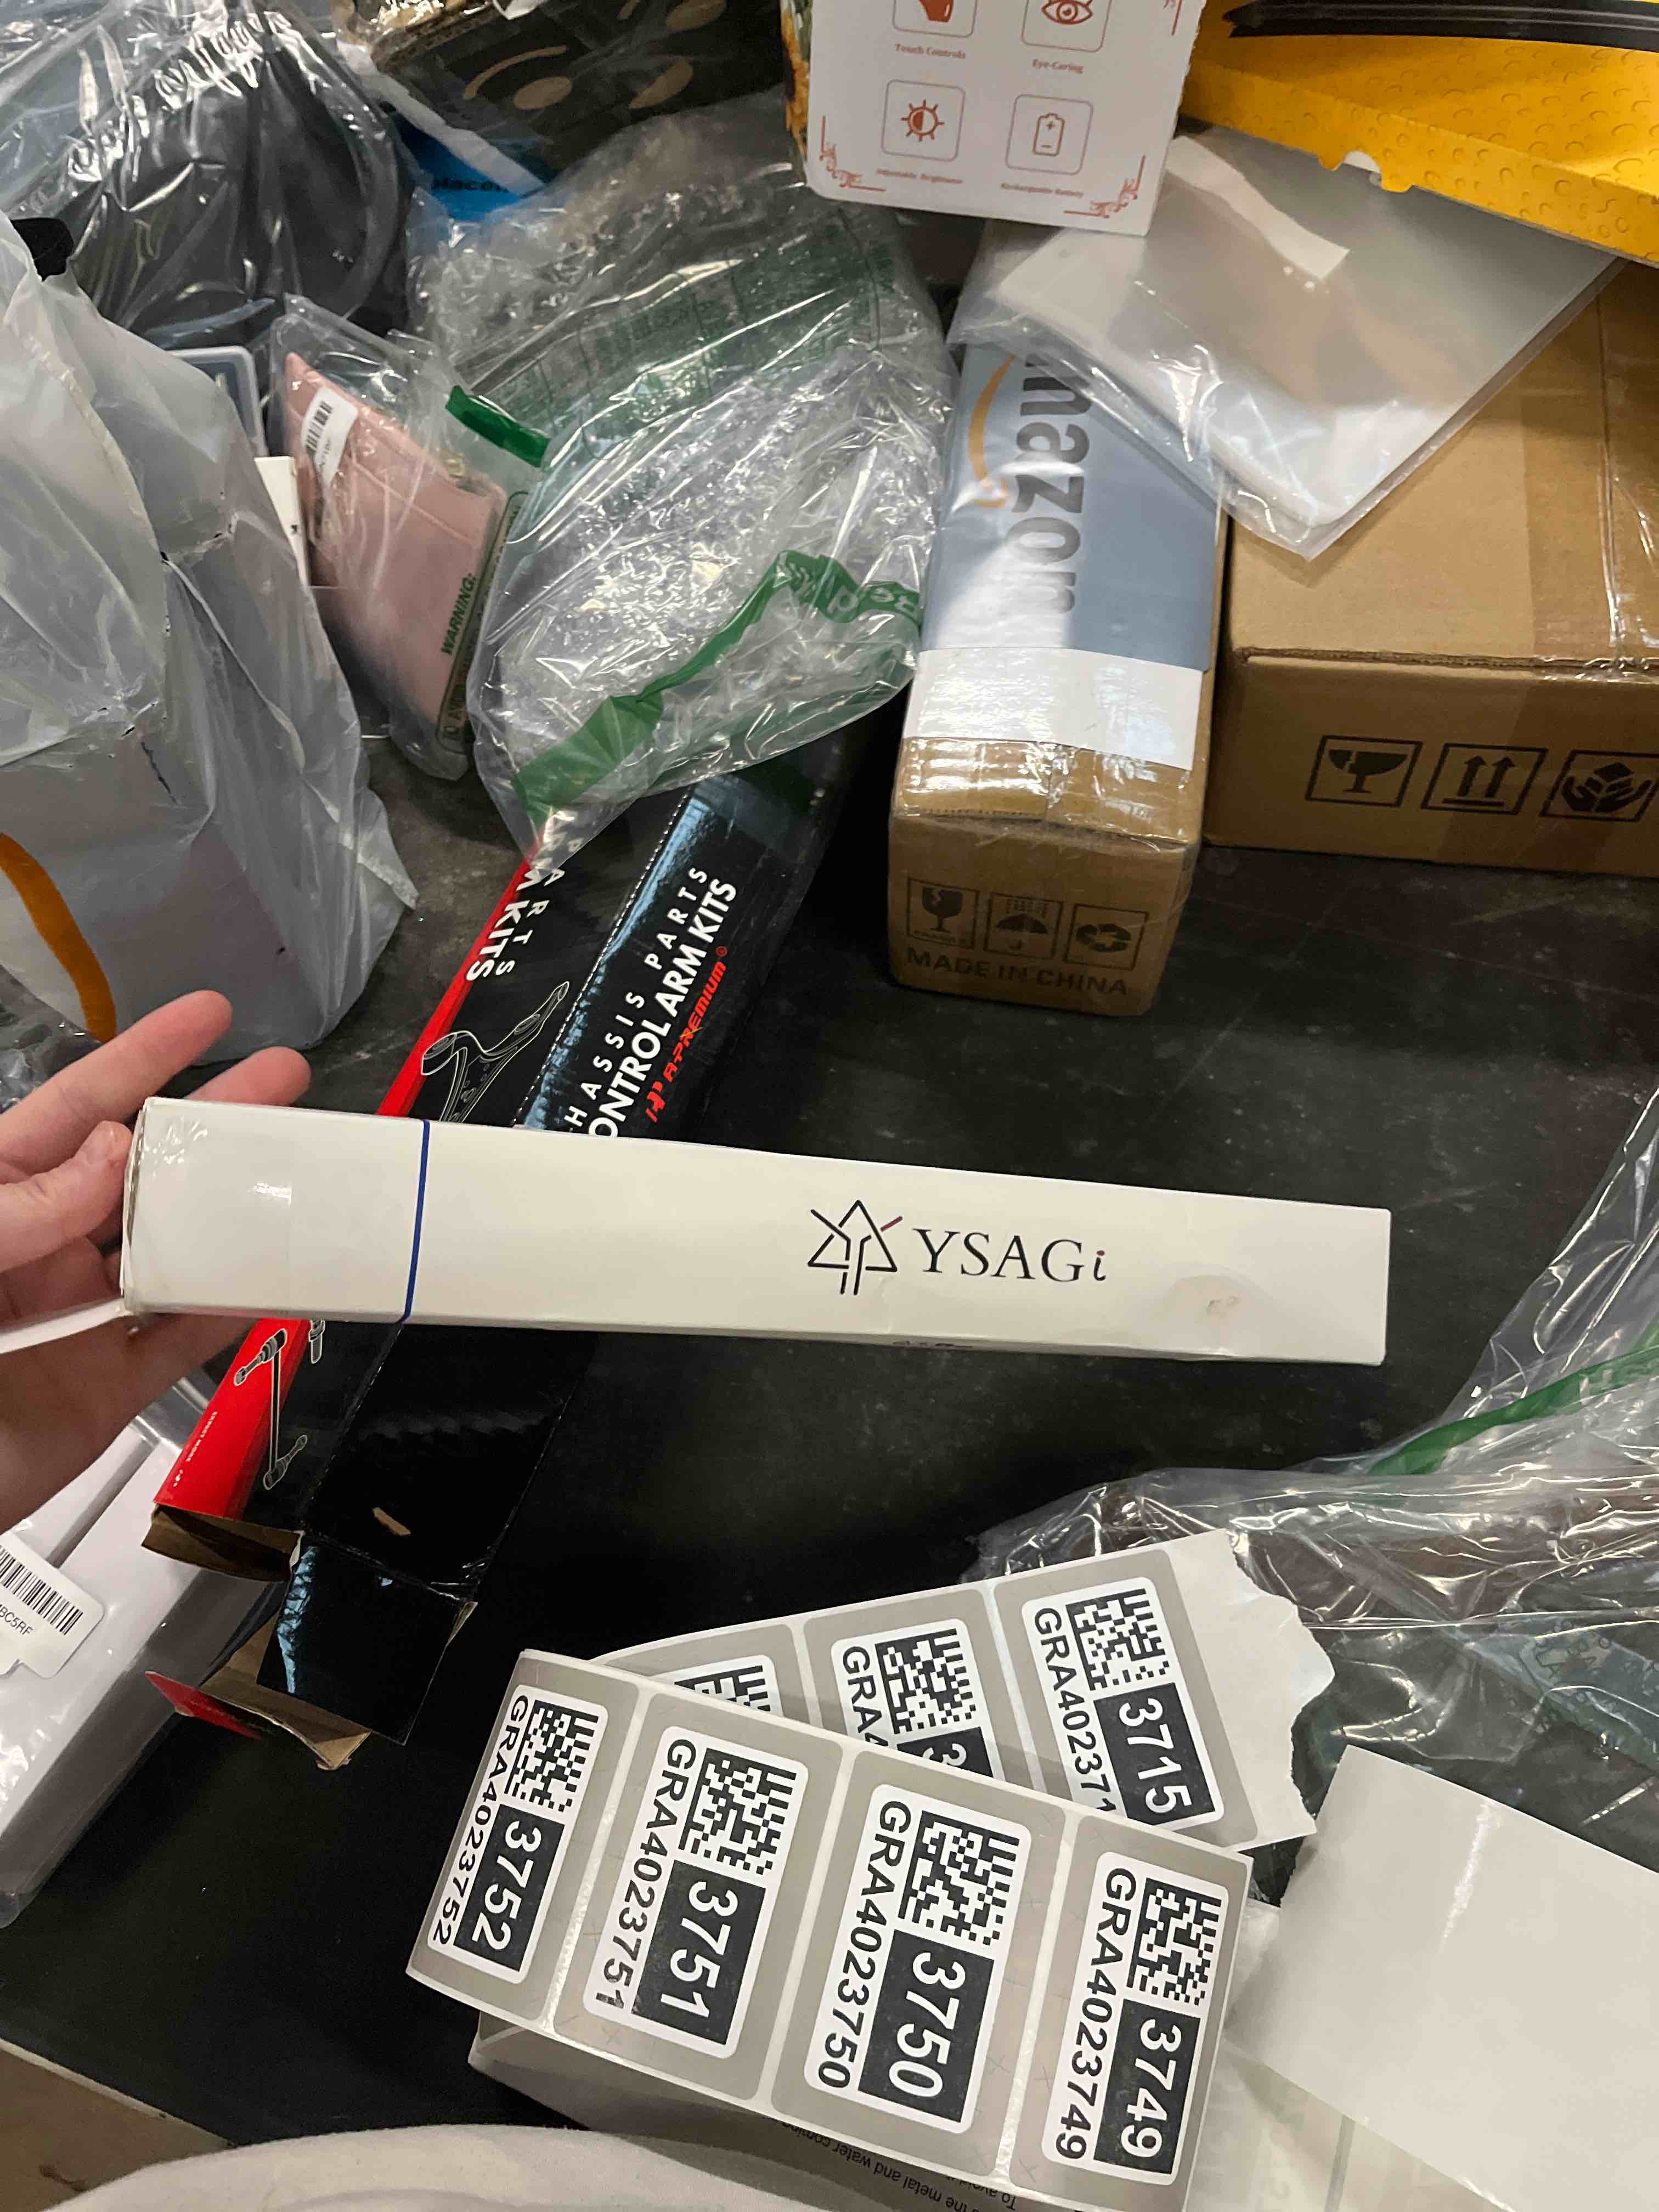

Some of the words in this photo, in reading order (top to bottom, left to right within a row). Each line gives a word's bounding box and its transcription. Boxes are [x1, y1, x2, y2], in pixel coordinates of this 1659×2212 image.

[895, 43, 923, 54] Touch
[1004, 353, 1093, 614] mazon
[441, 573, 476, 654] WARNING:
[466, 900, 531, 981] KITS
[565, 992, 645, 1131] HASSIS
[645, 867, 708, 970] PARTS
[907, 946, 989, 979] MADE
[998, 965, 1029, 983] IN
[1036, 969, 1128, 995] CHINA
[589, 1019, 672, 1137] ONTROL
[655, 944, 707, 1017] ARM
[690, 879, 737, 944] KITS
[912, 1228, 1107, 1282] YSAGi
[0, 1604, 33, 1636] BC5RF
[1034, 1607, 1117, 1812] GRA402371
[1118, 1698, 1193, 1814] 3715
[433, 1695, 529, 1945] GRA4023752
[471, 1820, 543, 1951] 3752
[595, 1739, 697, 2009] GRA4023751
[659, 1881, 738, 2019] 3751
[817, 1800, 912, 2089] GRA4023750
[888, 1951, 966, 2098] 3750
[1055, 1867, 1137, 2160] GRA4023749
[1120, 2018, 1182, 2159] 3749
[832, 2142, 871, 2169] water
[873, 2161, 901, 2182] and
[903, 2176, 942, 2204] metal
[1001, 2192, 1017, 2211] To
